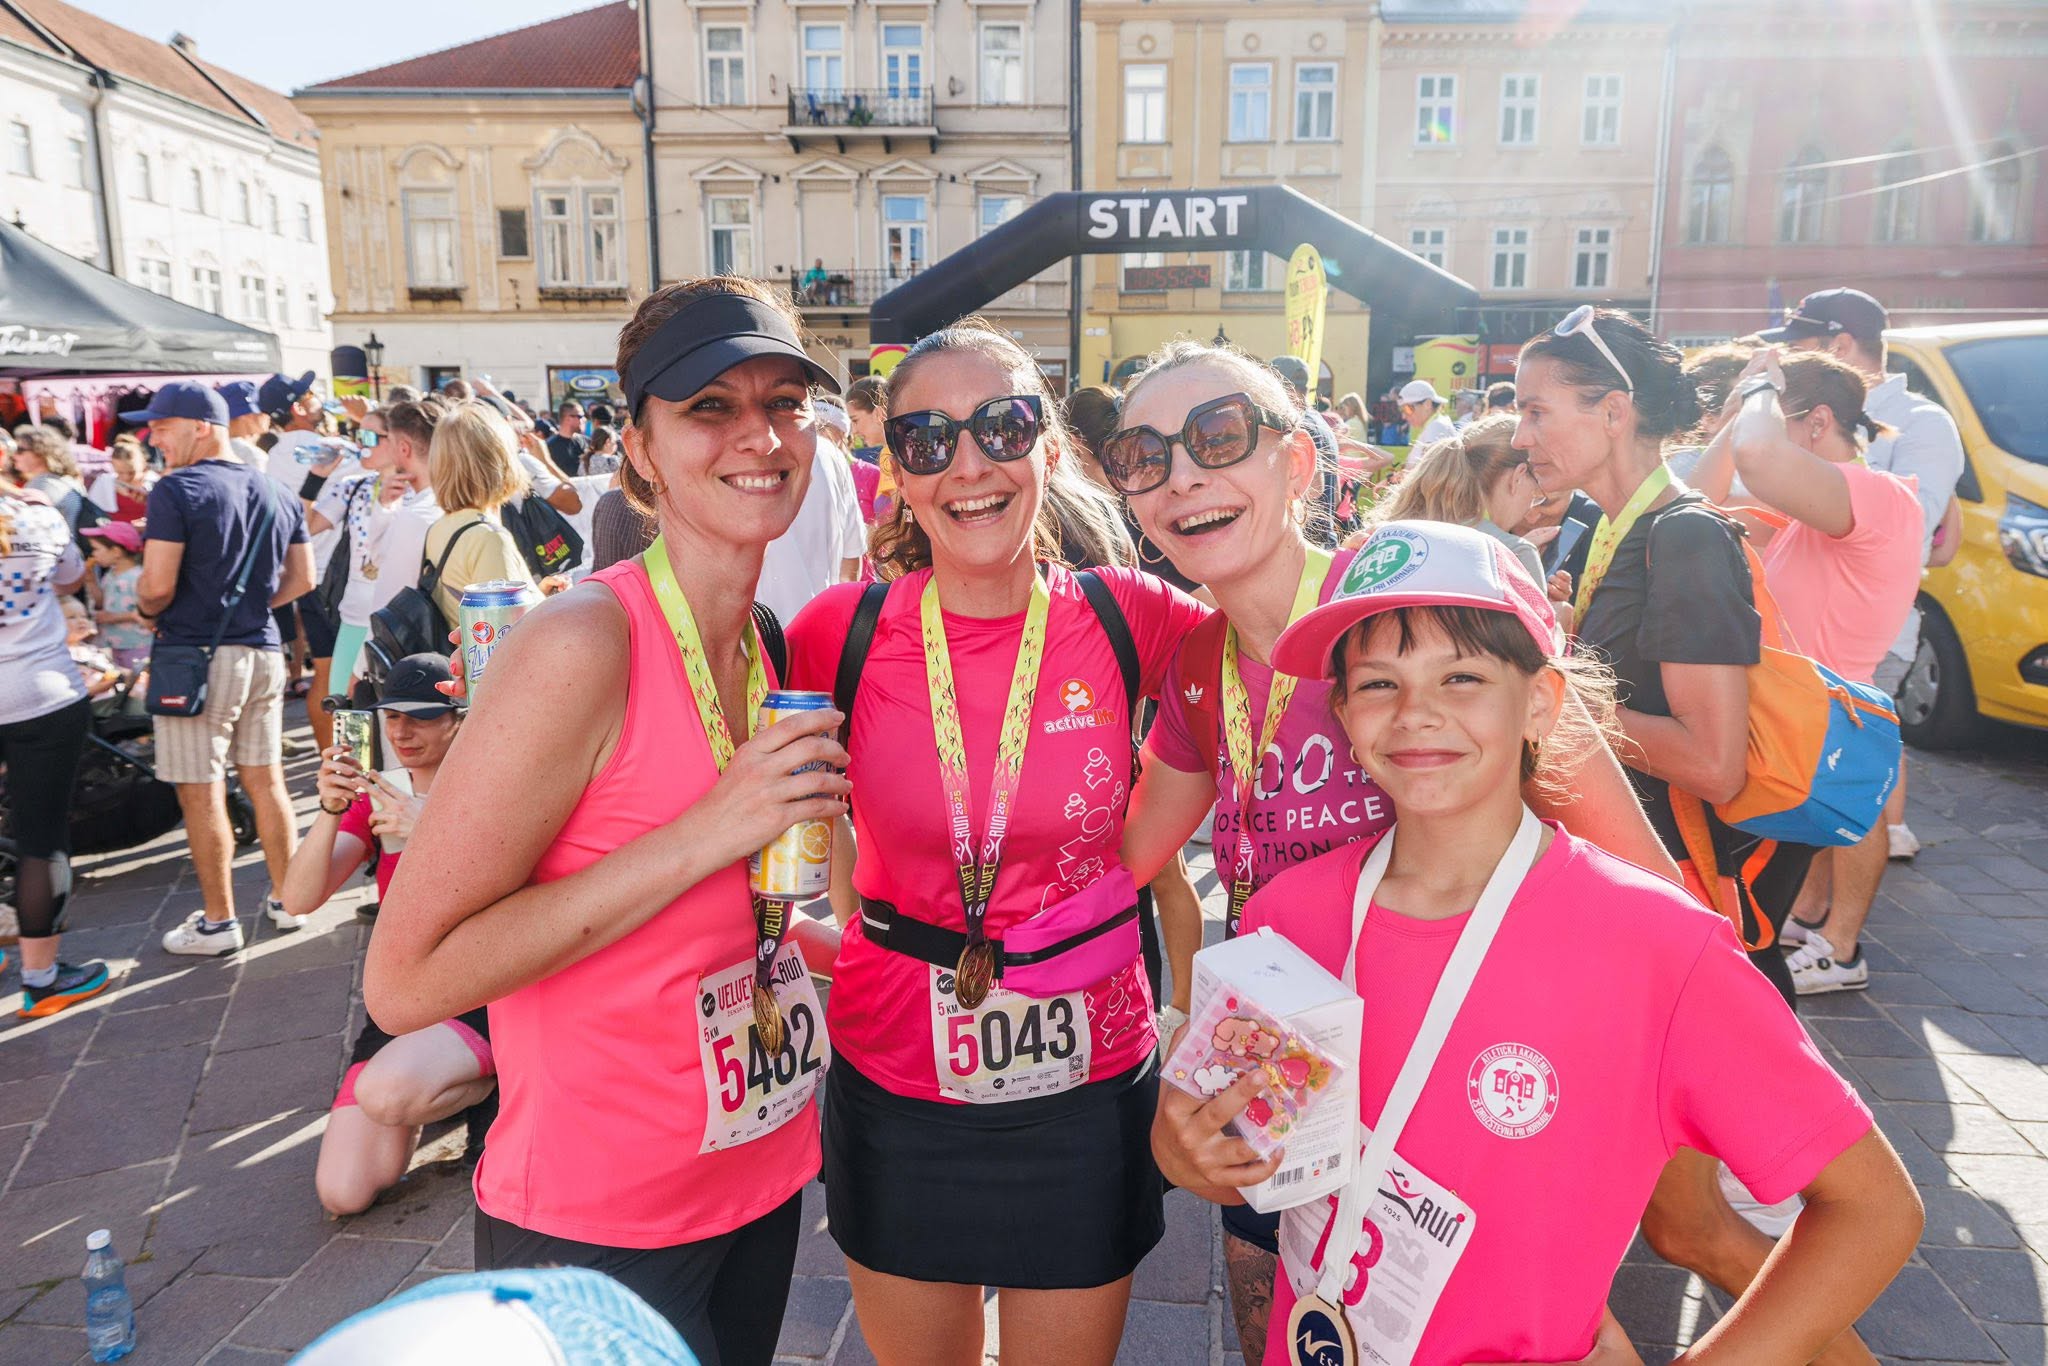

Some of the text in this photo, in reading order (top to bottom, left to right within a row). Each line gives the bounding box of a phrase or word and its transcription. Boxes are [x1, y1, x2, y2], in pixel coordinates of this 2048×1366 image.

[1088, 195, 1247, 239] START
[953, 790, 964, 816] 2025
[996, 790, 1009, 816] 2025
[1286, 795, 1385, 832] PEACE
[937, 1002, 958, 1016] 5 KM
[703, 1026, 719, 1043] 5 KM
[948, 997, 1077, 1077] 5043
[1383, 1204, 1401, 1222] 2025
[1414, 1196, 1461, 1248] RUN
